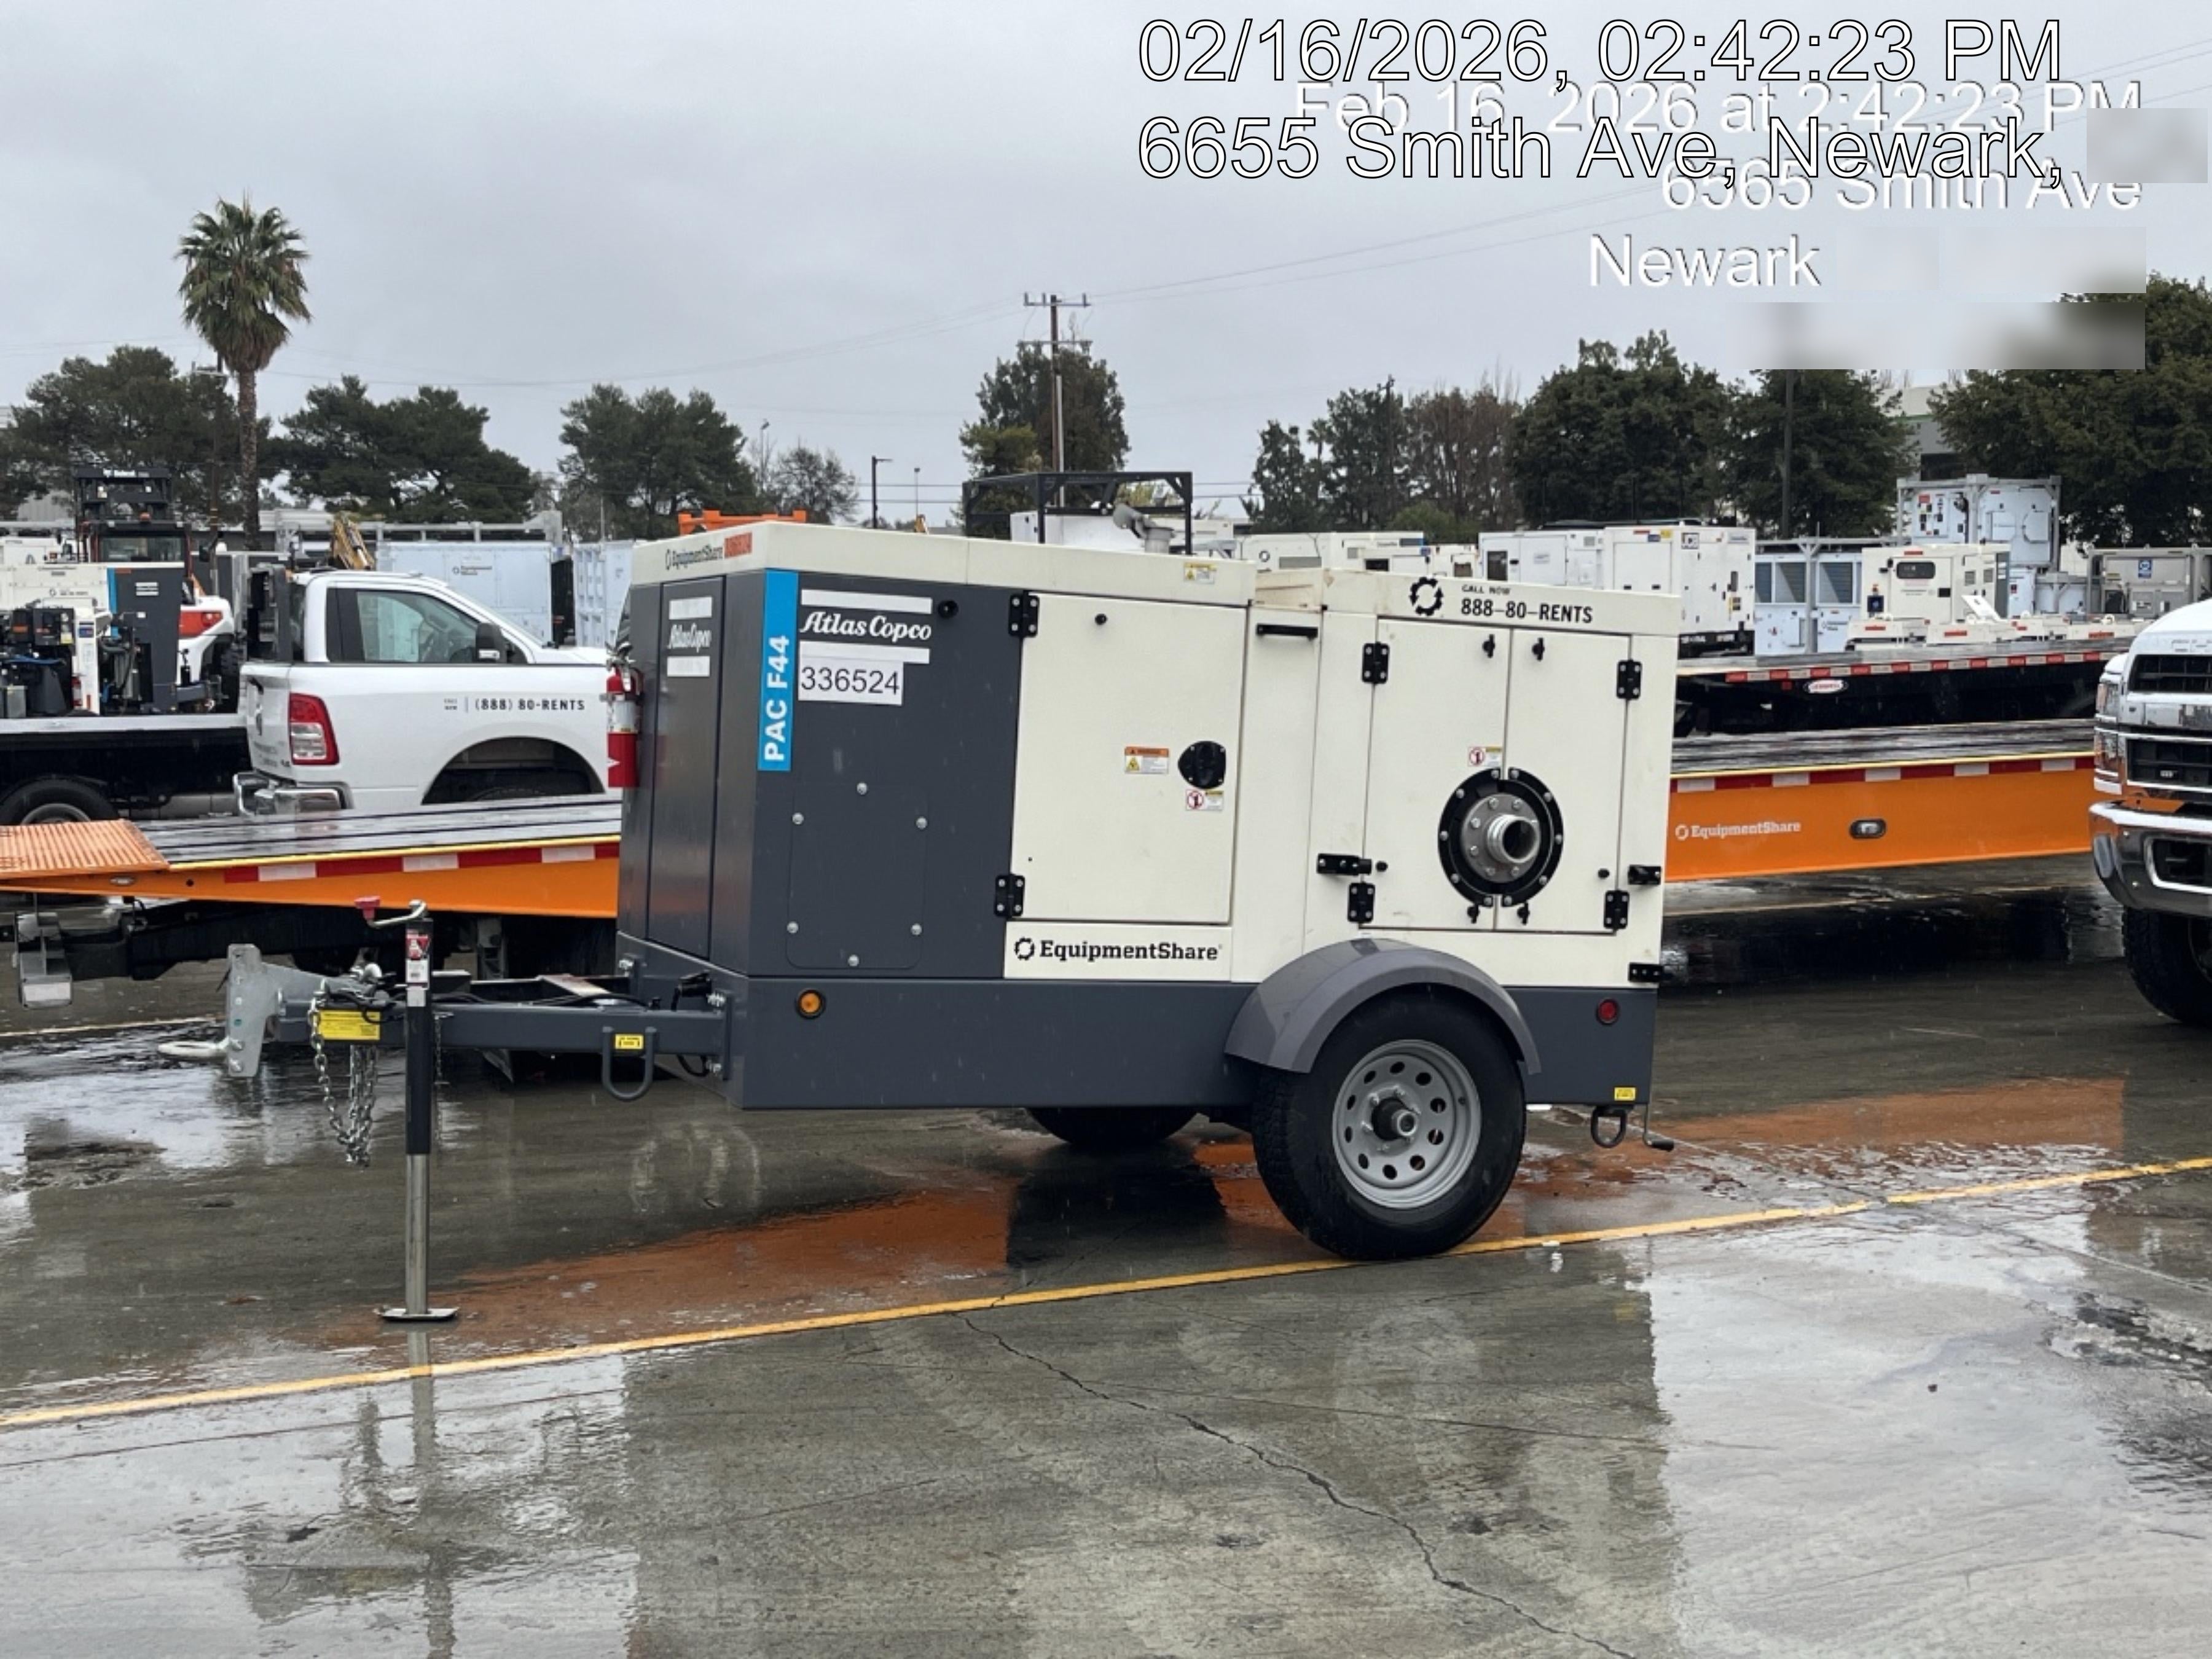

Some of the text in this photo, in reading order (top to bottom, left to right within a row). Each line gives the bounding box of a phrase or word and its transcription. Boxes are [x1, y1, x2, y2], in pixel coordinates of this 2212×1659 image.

[1461, 597, 1593, 624] 888-80-RENTS
[800, 611, 932, 643] Atlas Copco
[801, 667, 900, 696] 336524
[475, 698, 585, 711] (888) 80-RENTS
[764, 635, 790, 761] PAC F44
[1691, 821, 1802, 841] EquipmentShare
[1039, 940, 1219, 962] EquipmentShare
